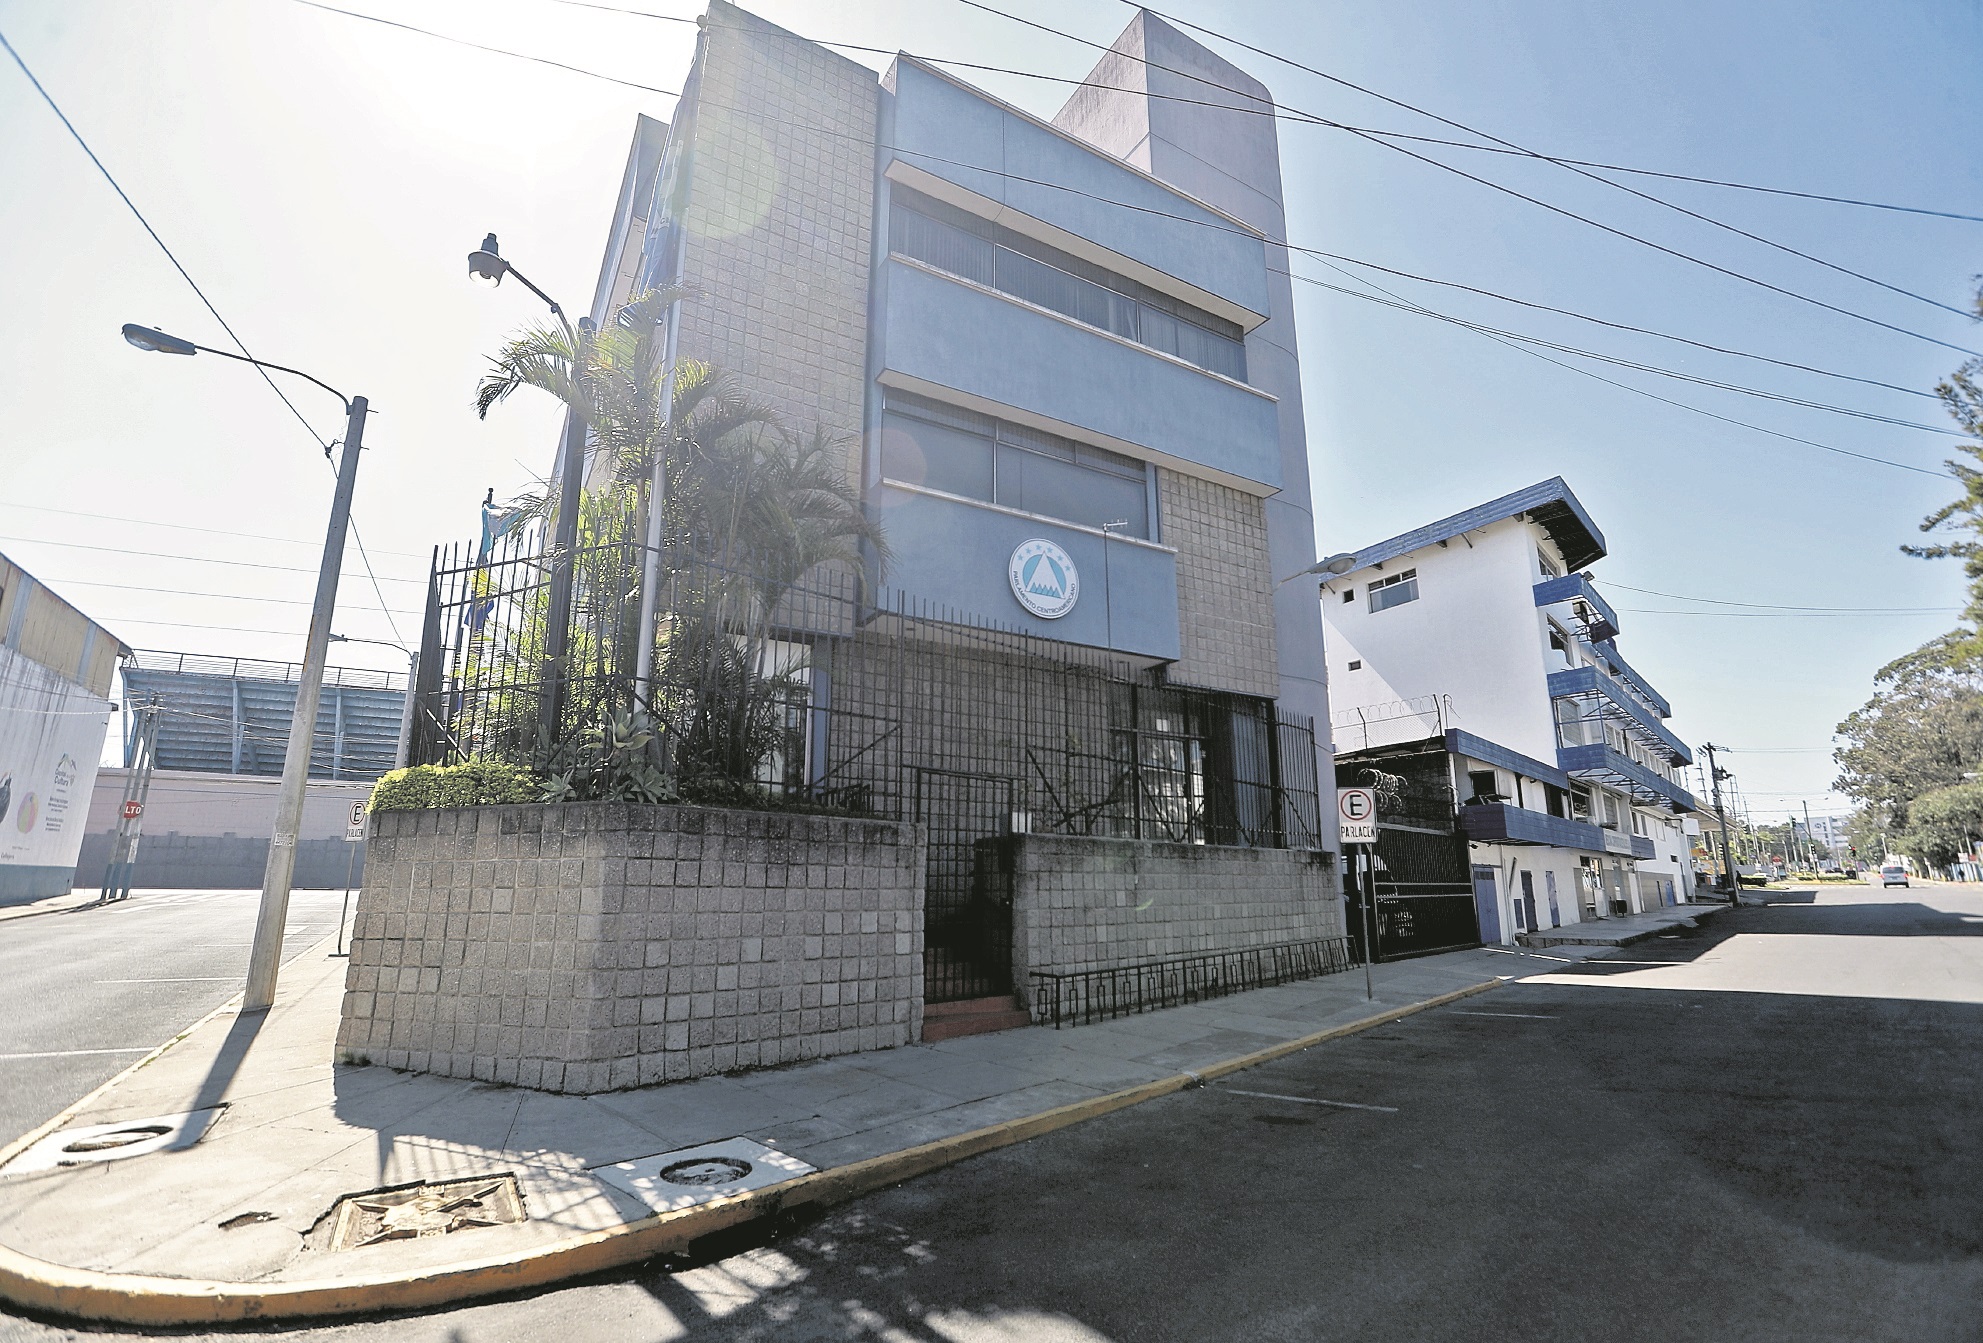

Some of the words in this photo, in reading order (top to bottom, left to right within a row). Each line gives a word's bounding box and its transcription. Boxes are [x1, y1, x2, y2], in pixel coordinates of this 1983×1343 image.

[1013, 570, 1036, 609] PARLAMENTO
[1037, 583, 1075, 614] CENTROAMERICANO
[125, 806, 141, 814] LTO
[353, 805, 362, 822] E
[1350, 794, 1363, 816] E
[1340, 826, 1375, 838] PARLACEN
